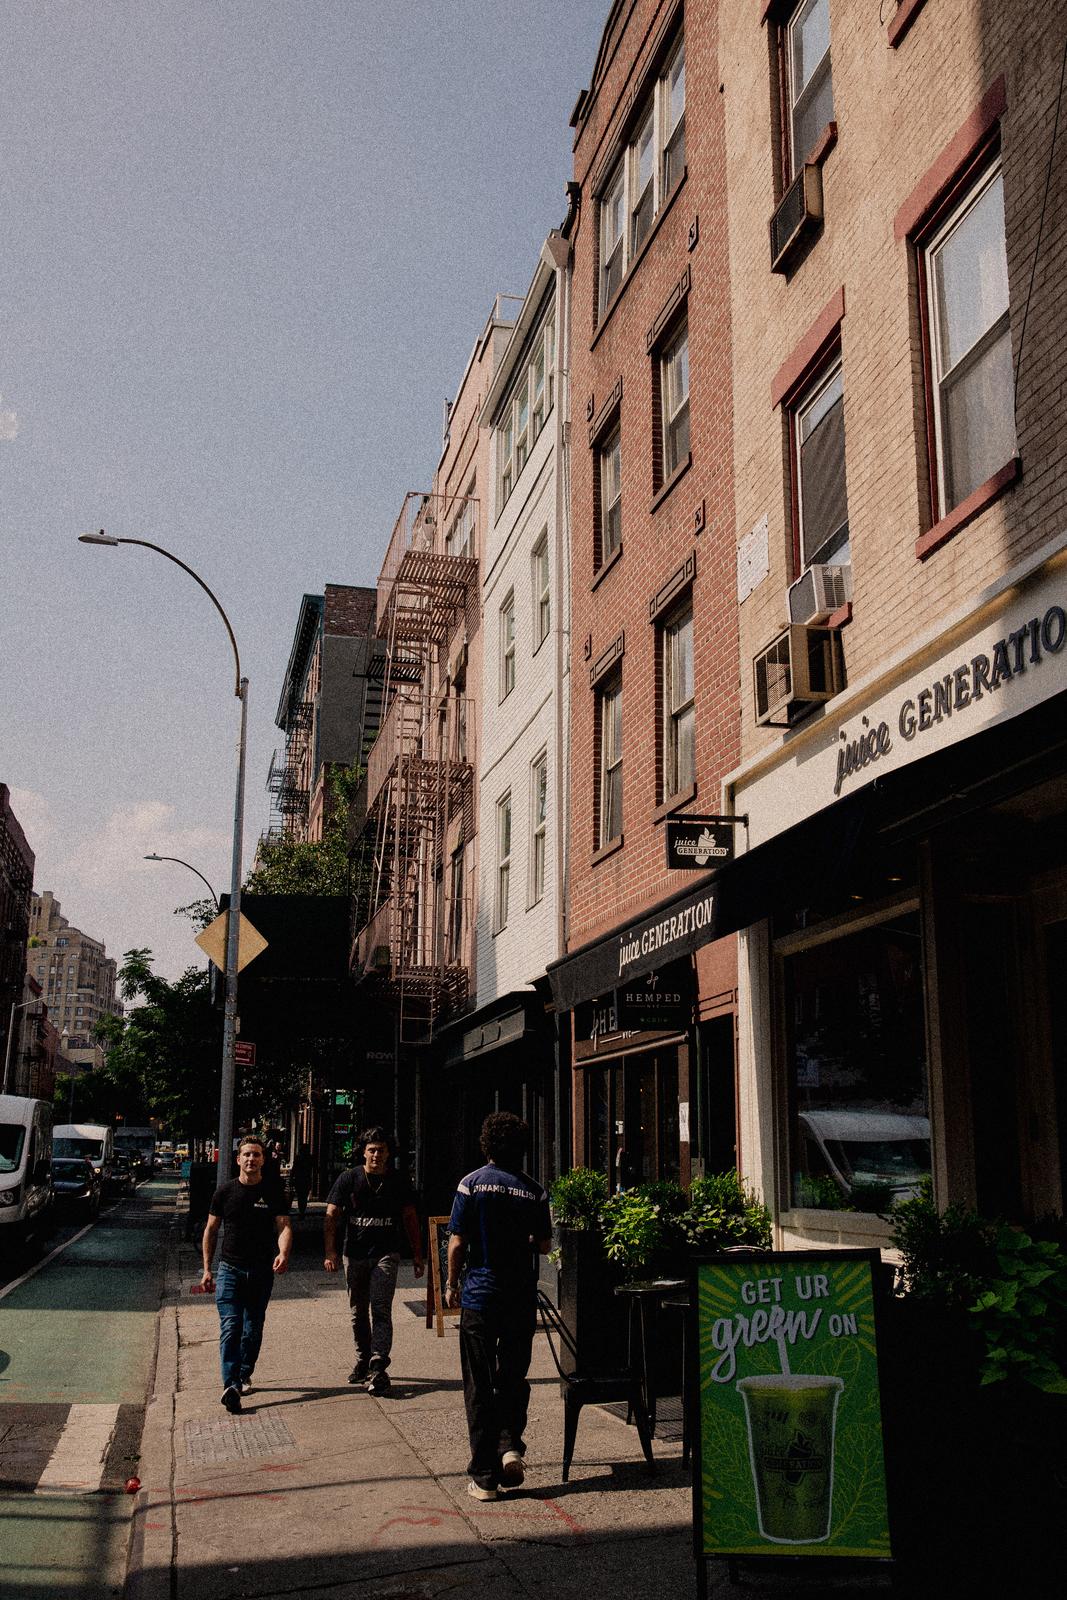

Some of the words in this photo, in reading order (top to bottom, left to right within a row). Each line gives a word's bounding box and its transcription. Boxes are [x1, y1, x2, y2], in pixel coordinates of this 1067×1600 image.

[834, 715, 892, 796] juice
[899, 606, 1065, 741] GENERATIO
[674, 836, 697, 848] juice
[678, 847, 725, 855] GENERATION
[618, 932, 640, 976] juice
[641, 896, 714, 955] GENERATION
[625, 993, 681, 1002] HEMPED
[473, 1184, 506, 1194] DINAMO
[507, 1186, 536, 1200] TBILISI
[741, 1278, 783, 1304] GET
[795, 1274, 829, 1300] UR
[711, 1304, 822, 1383] green
[829, 1313, 858, 1336] ON
